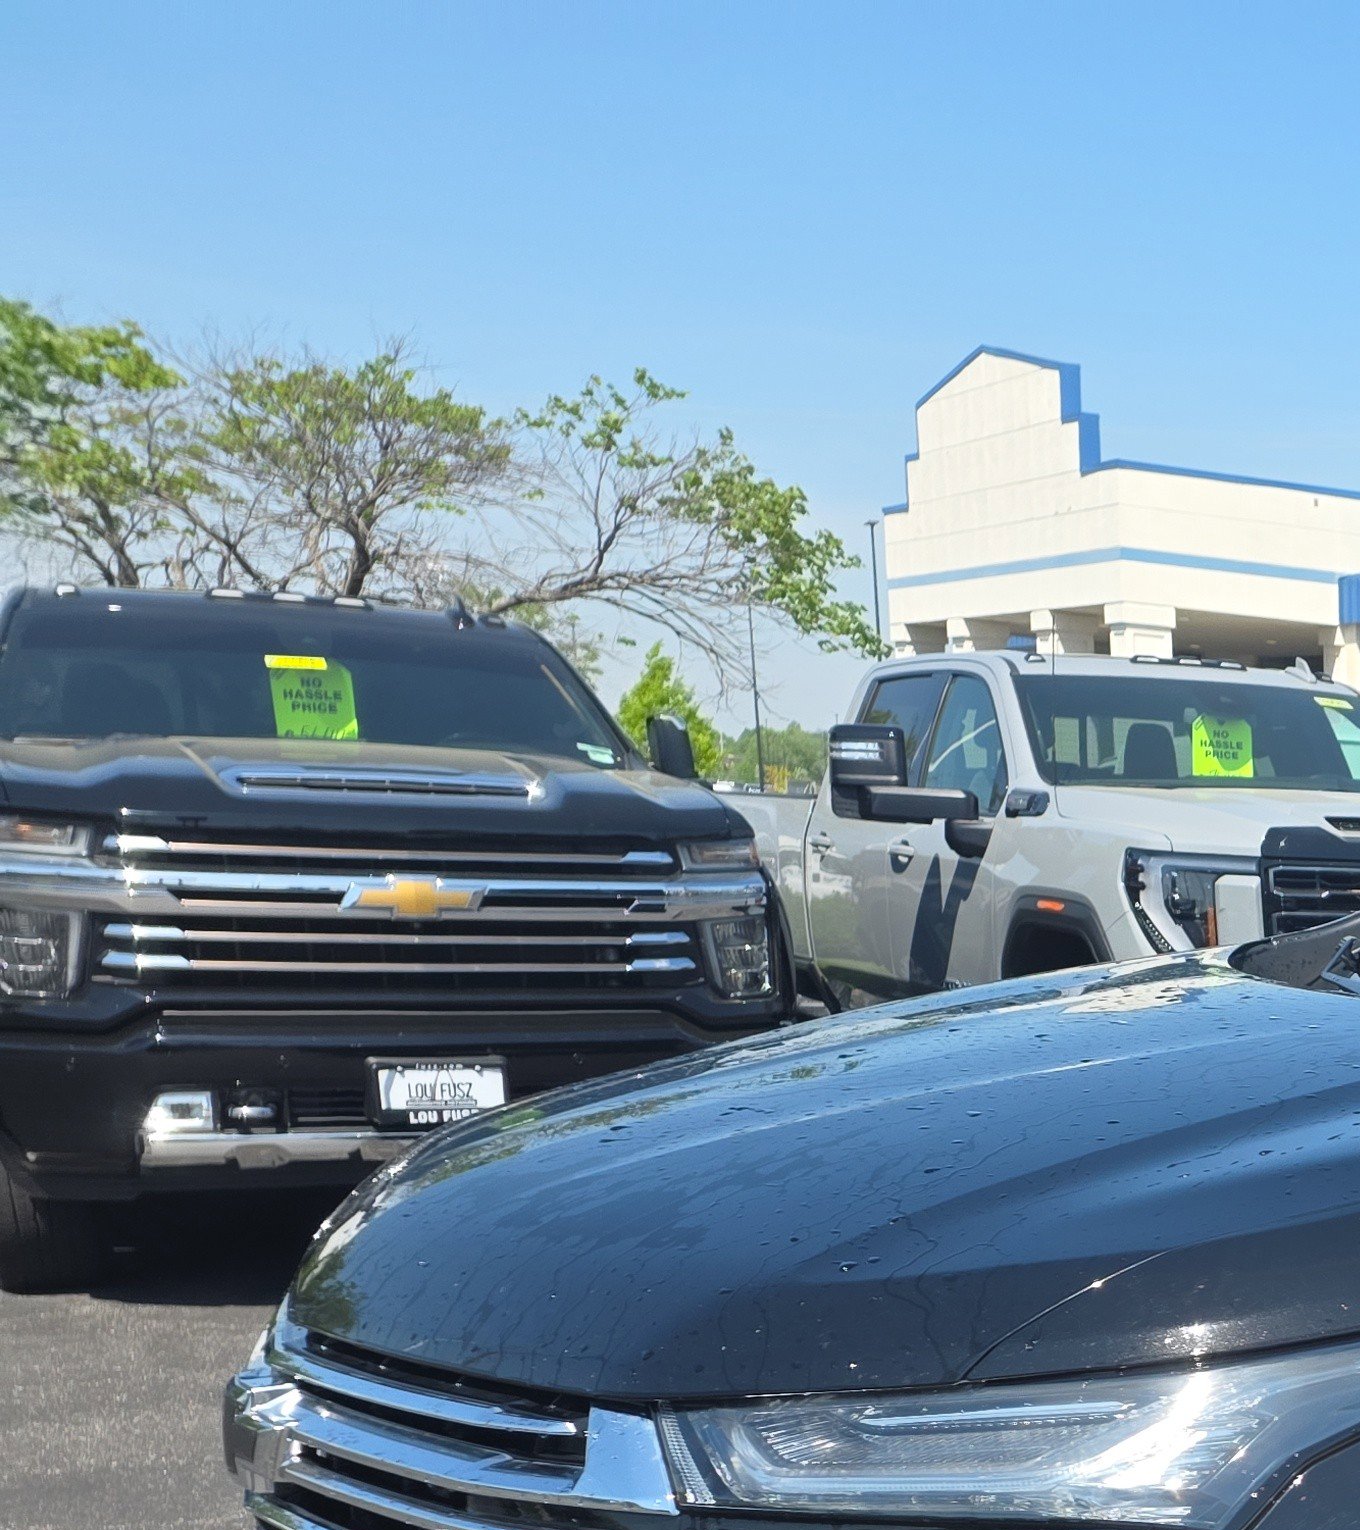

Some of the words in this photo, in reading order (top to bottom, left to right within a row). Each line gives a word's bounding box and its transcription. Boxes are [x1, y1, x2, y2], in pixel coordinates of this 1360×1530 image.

[301, 677, 322, 687] NO
[283, 688, 342, 701] HASSLE
[291, 701, 338, 714] PRICE
[1213, 730, 1230, 739] NO
[1200, 739, 1243, 750] HASSLE
[1205, 750, 1239, 759] PRICE
[407, 1082, 433, 1099] LOU
[440, 1082, 473, 1099] FUSZ
[408, 1109, 438, 1125] LOU
